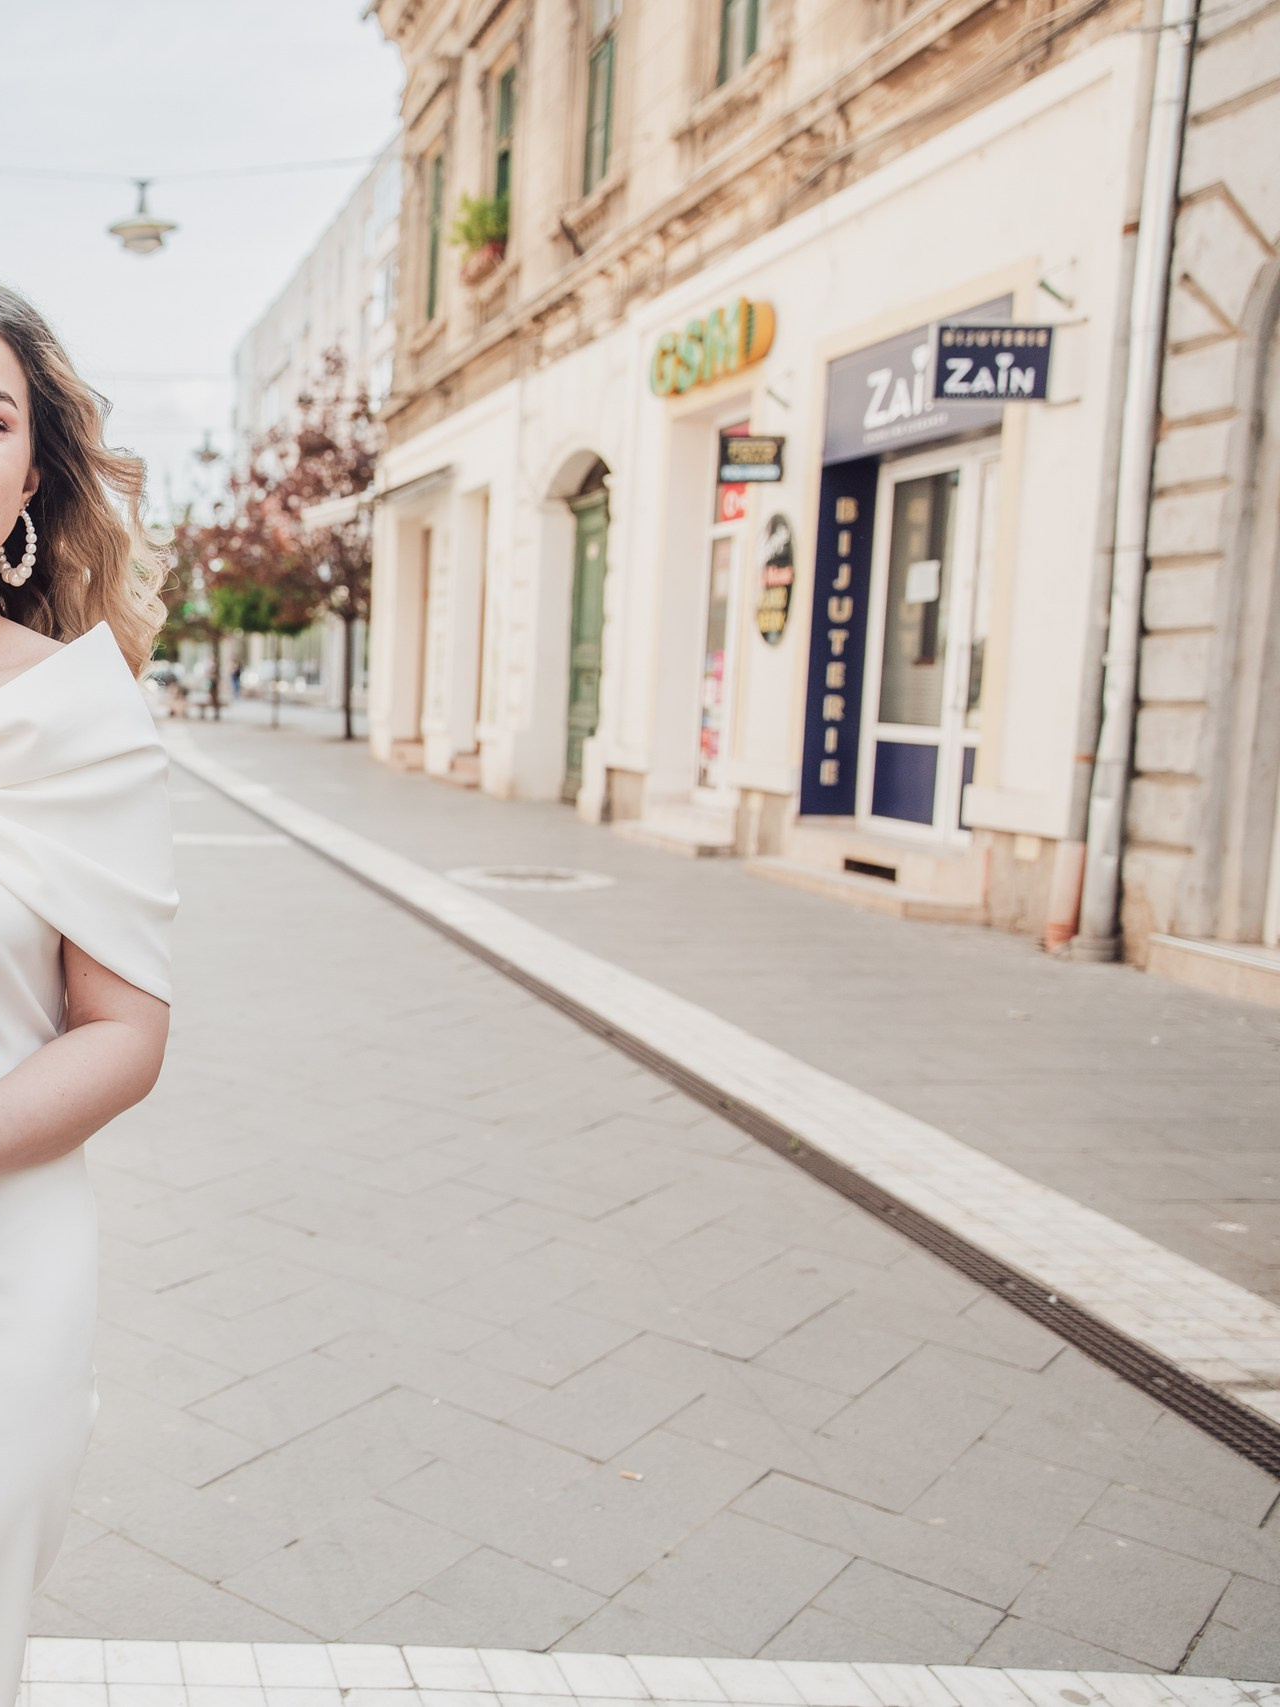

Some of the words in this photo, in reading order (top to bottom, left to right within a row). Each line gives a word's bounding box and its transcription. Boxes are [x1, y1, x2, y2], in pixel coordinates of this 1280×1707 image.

[650, 297, 749, 397] GSM
[941, 329, 1049, 348] BIJUTERIE
[862, 344, 931, 430] ZAI
[819, 496, 859, 787] BIJUTERIE
